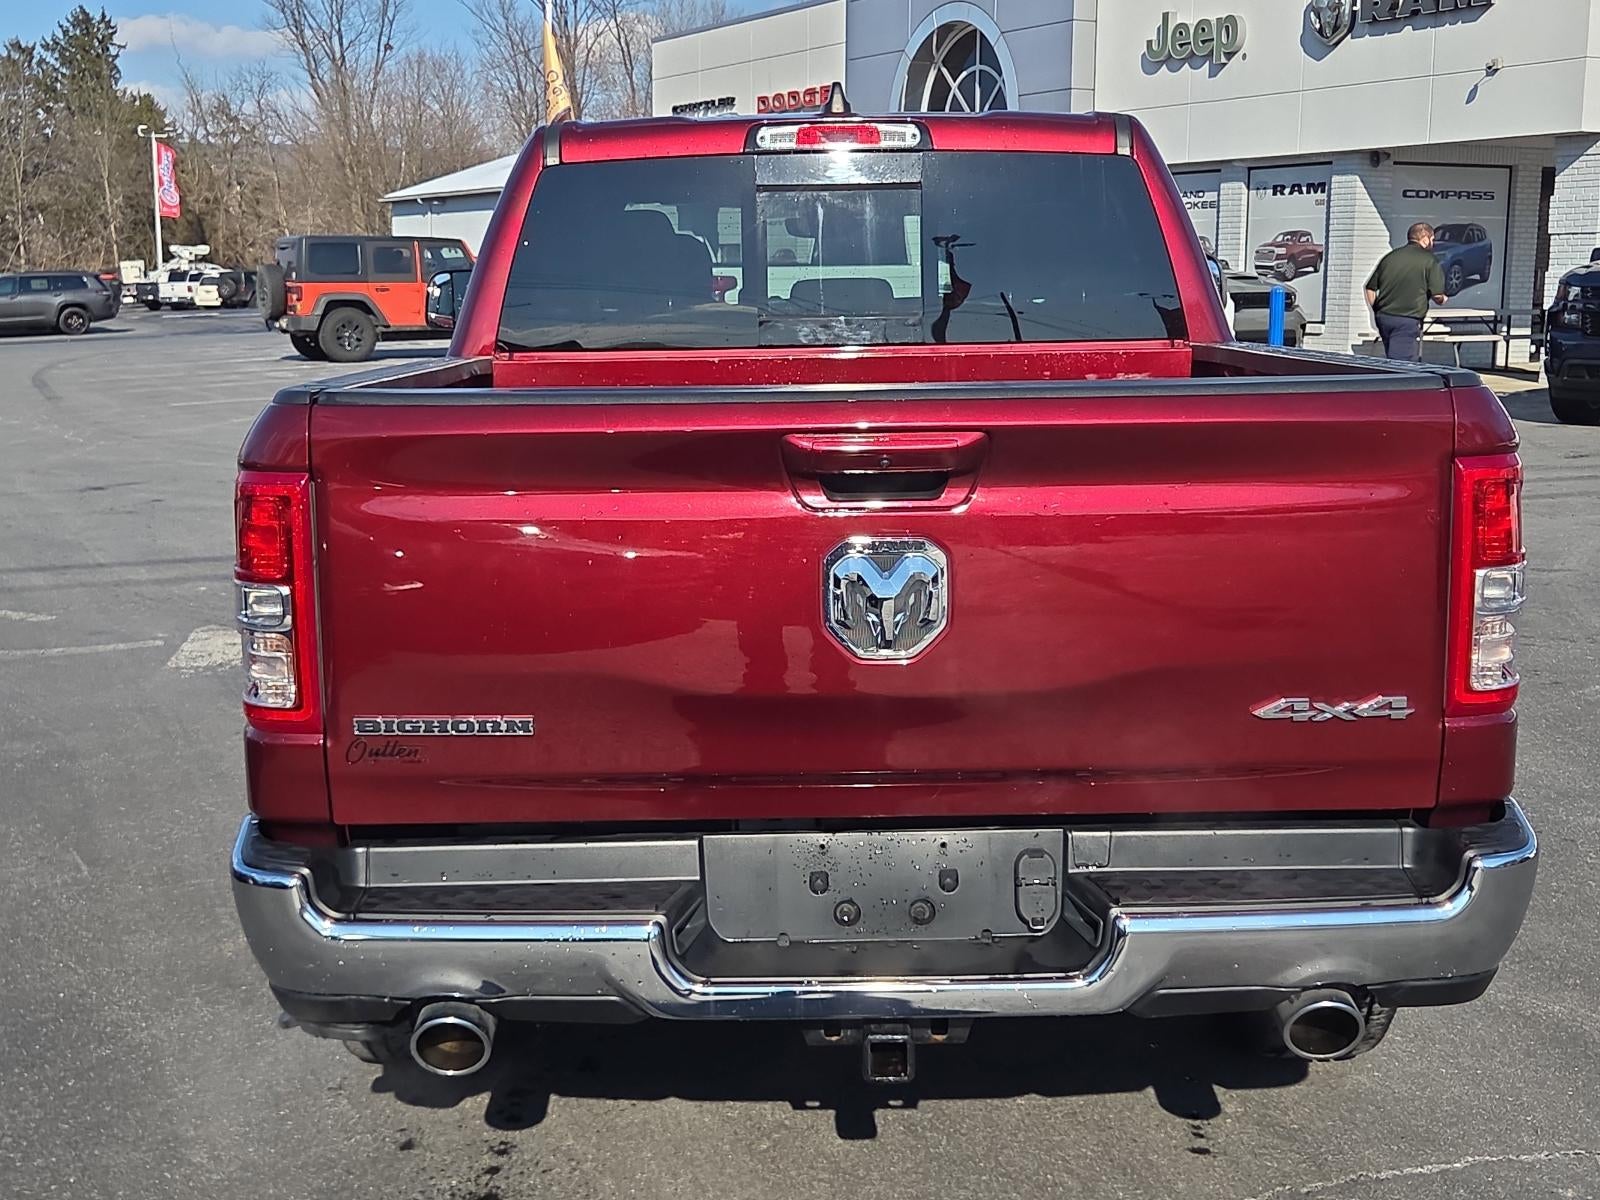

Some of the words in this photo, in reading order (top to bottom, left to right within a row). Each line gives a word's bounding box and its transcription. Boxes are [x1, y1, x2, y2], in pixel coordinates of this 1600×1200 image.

[1360, 0, 1492, 23] RA
[1146, 11, 1242, 64] Jeep
[757, 85, 832, 113] DODGE
[1272, 182, 1326, 196] RAM
[1402, 189, 1496, 200] COMPASS
[1250, 696, 1416, 722] 4x4
[353, 717, 535, 736] BIGHORN
